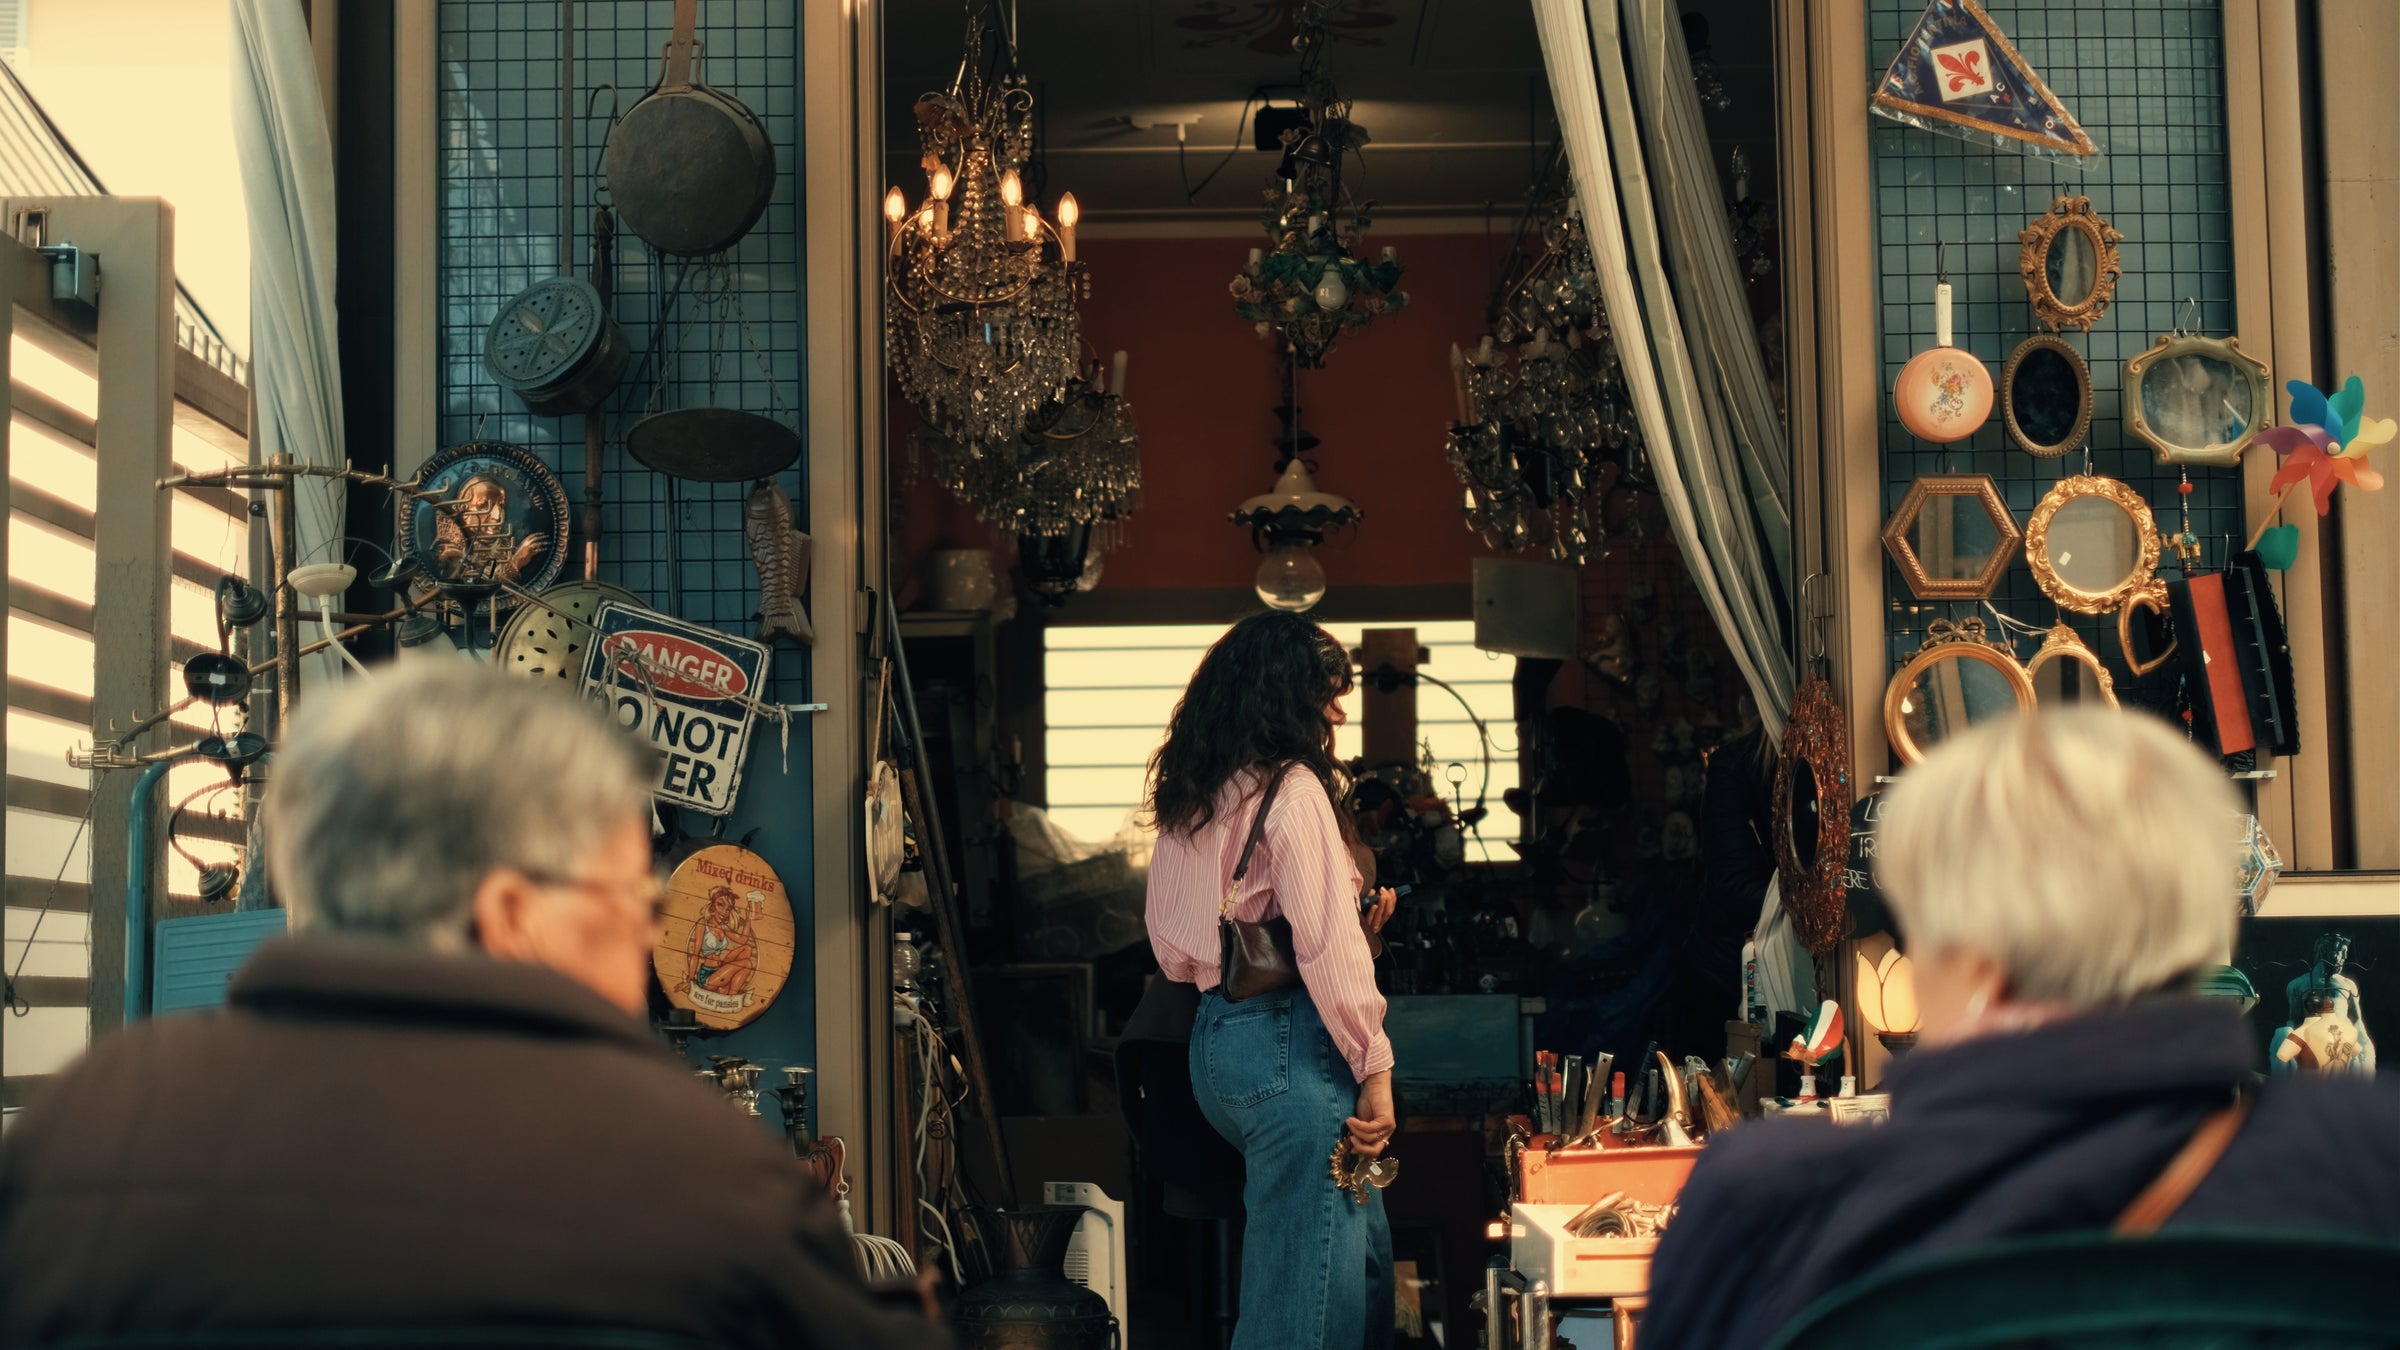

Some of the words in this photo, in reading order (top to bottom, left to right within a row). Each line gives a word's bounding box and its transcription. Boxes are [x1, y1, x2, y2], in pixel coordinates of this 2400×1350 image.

[620, 636, 733, 691] DANGER
[651, 706, 740, 761] NOT
[696, 858, 733, 882] Mixed
[735, 869, 775, 892] drinks
